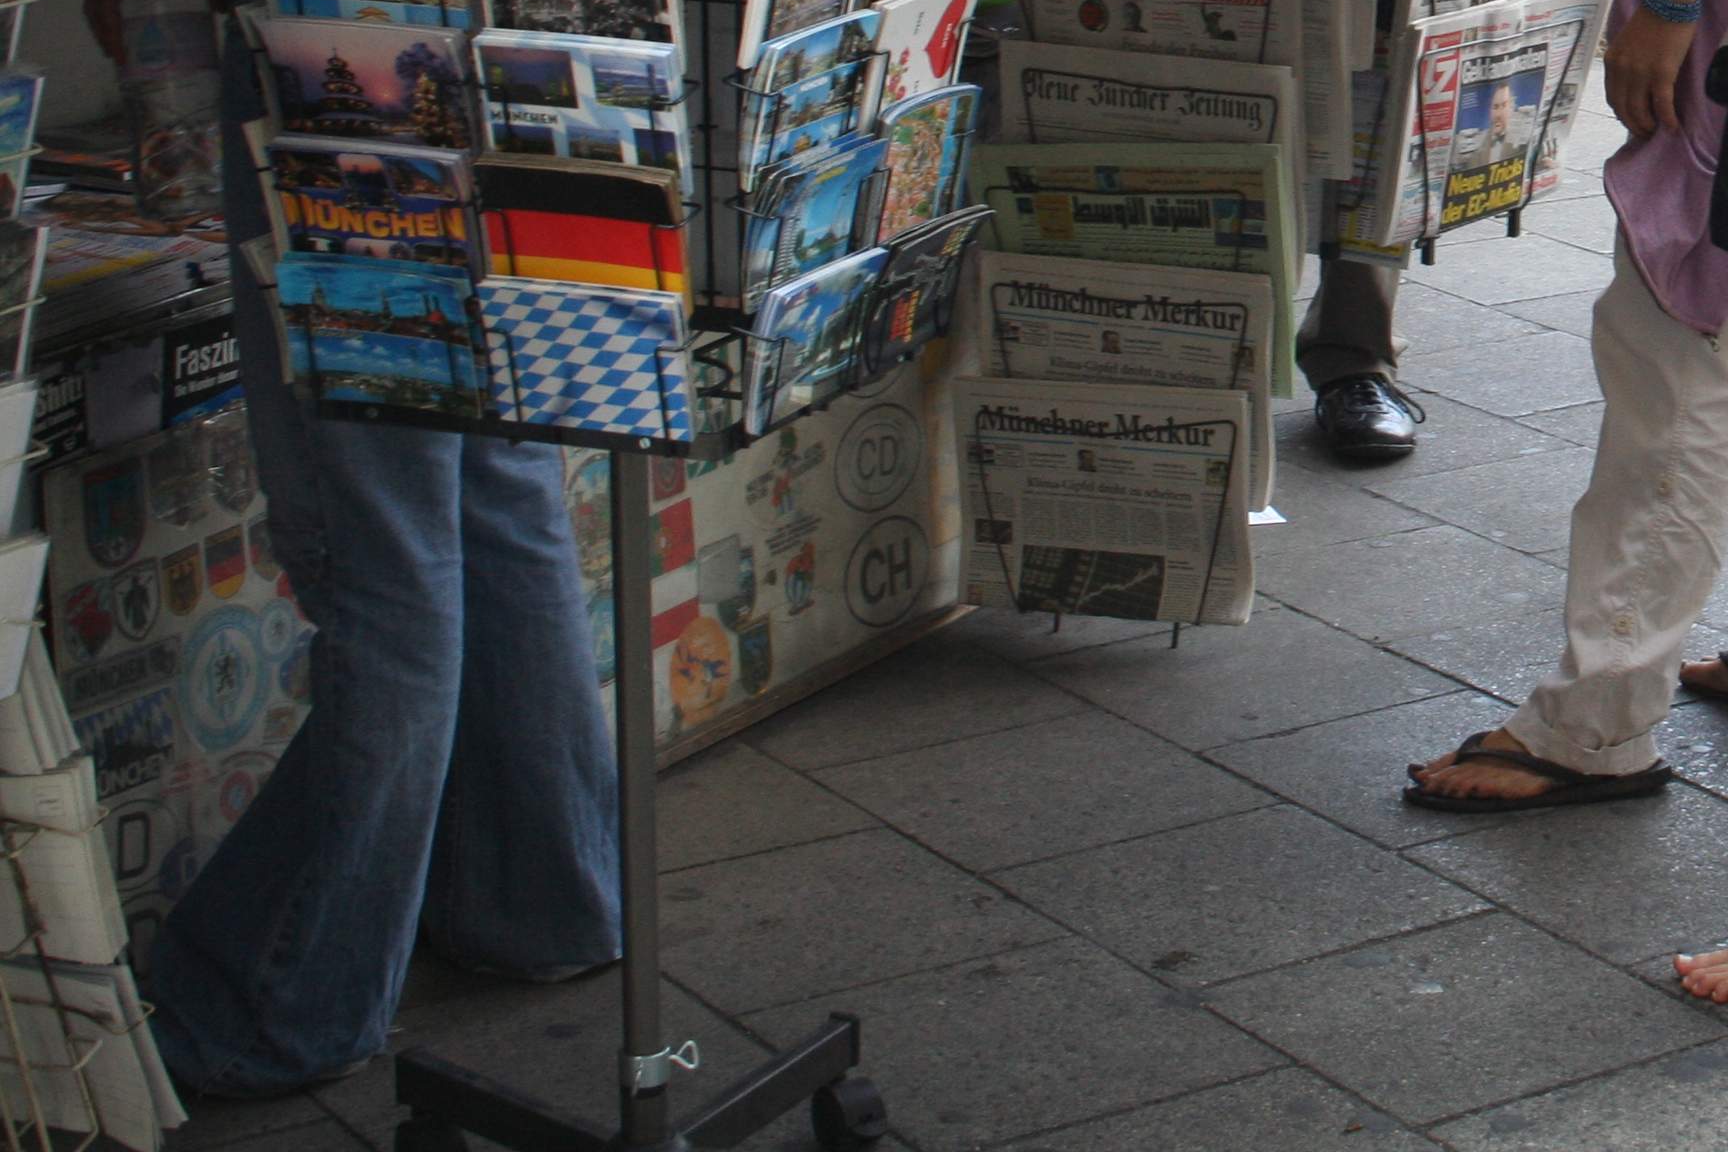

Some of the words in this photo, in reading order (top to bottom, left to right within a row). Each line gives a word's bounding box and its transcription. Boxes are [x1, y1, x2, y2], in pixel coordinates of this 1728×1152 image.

[1177, 88, 1263, 130] Zeitung
[1448, 171, 1486, 197] Neue
[282, 191, 467, 241] MÜNCHEN
[1441, 198, 1468, 225] der
[1008, 280, 1137, 320] Münchner
[1141, 294, 1243, 333] Merkur
[979, 404, 1111, 439] Münchner
[1112, 414, 1216, 449] Merkur
[856, 433, 899, 482] CD
[859, 535, 914, 605] CH
[117, 810, 150, 882] D
